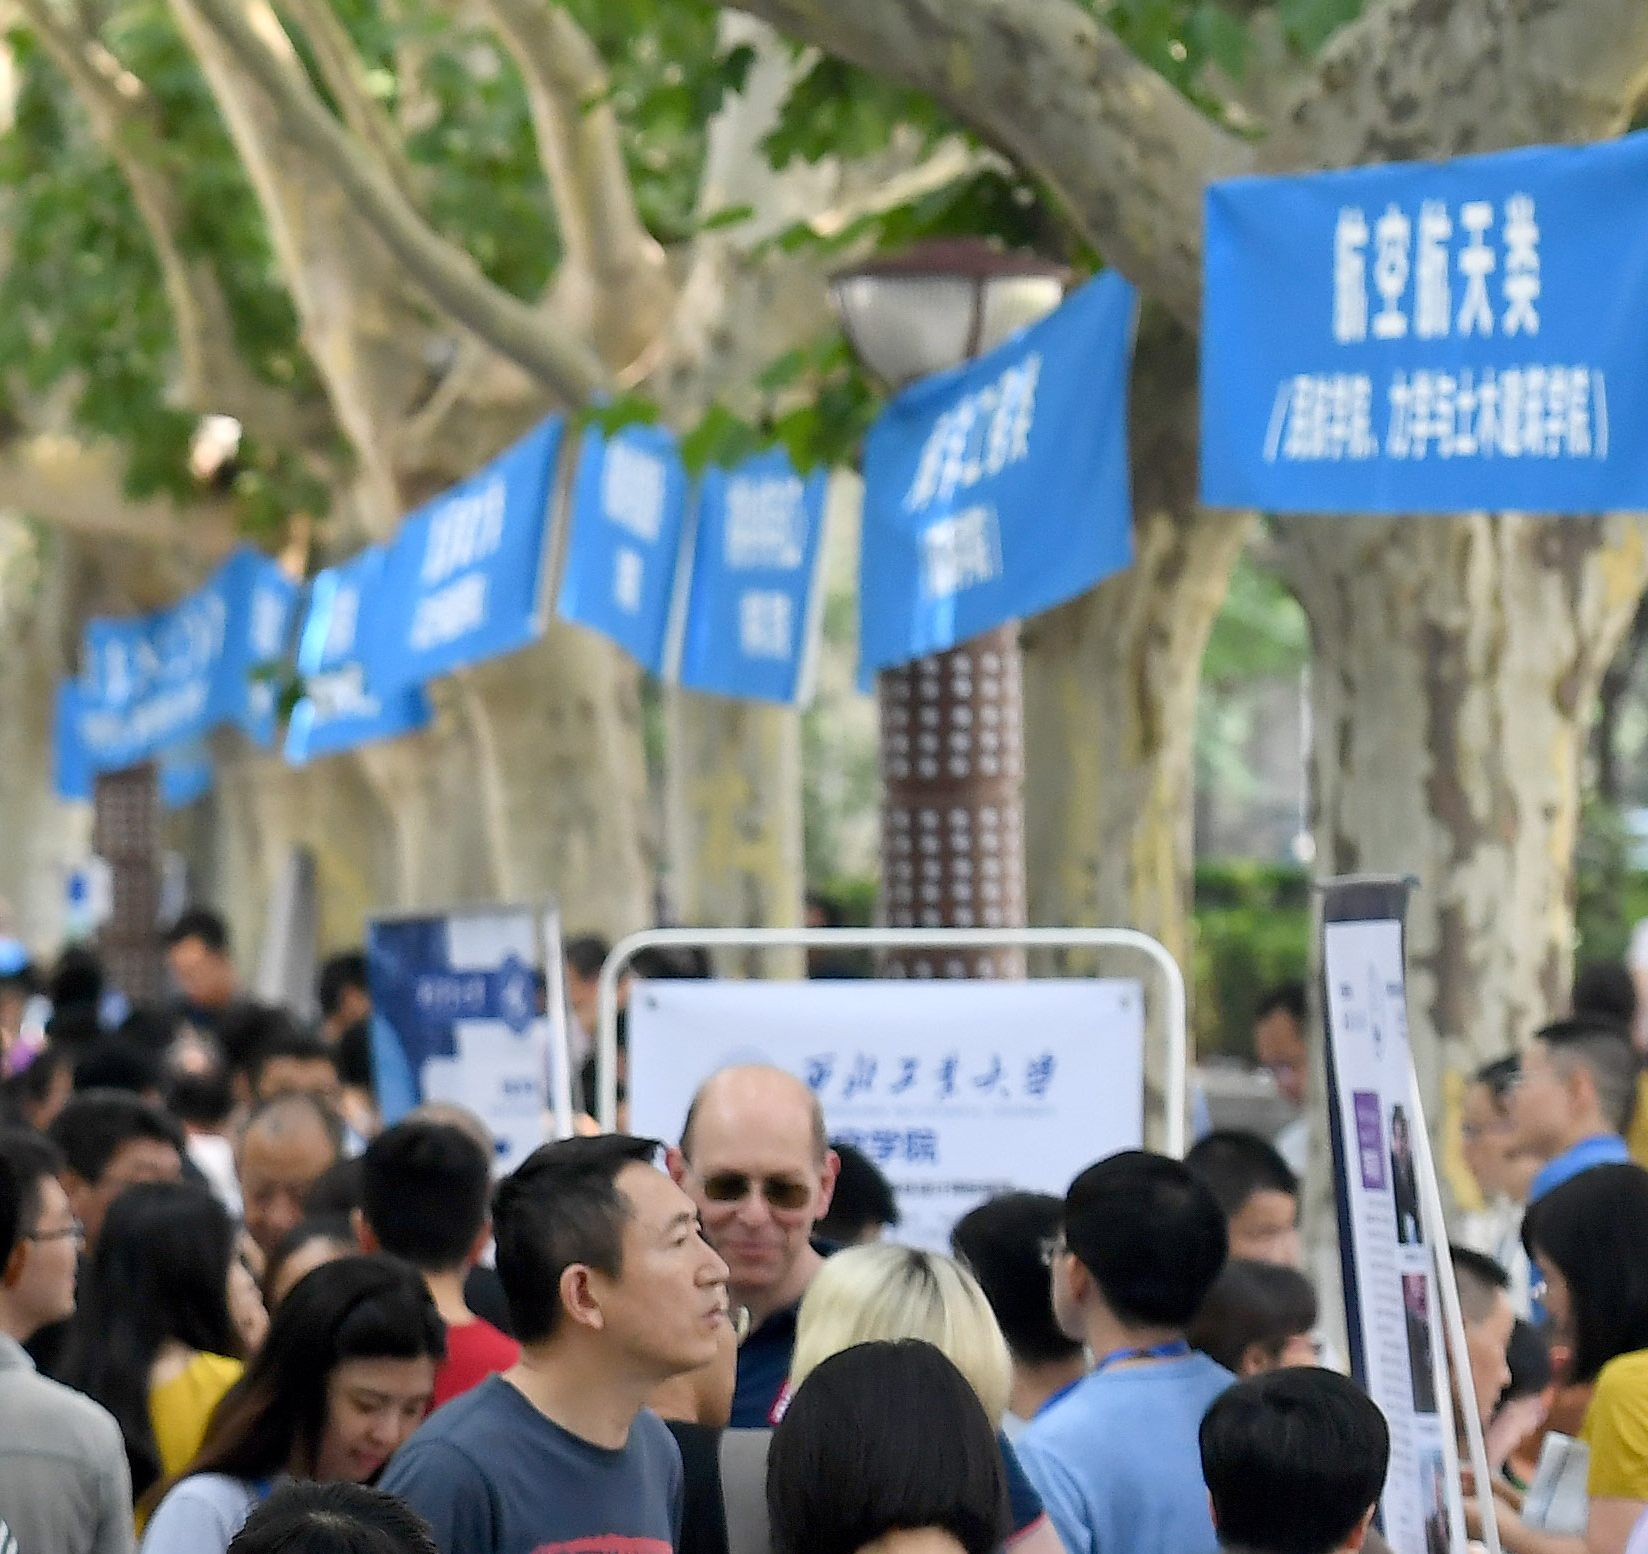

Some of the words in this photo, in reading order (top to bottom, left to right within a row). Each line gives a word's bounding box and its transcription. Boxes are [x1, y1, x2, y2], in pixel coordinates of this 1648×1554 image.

[1332, 192, 1541, 343] 航空航天类
